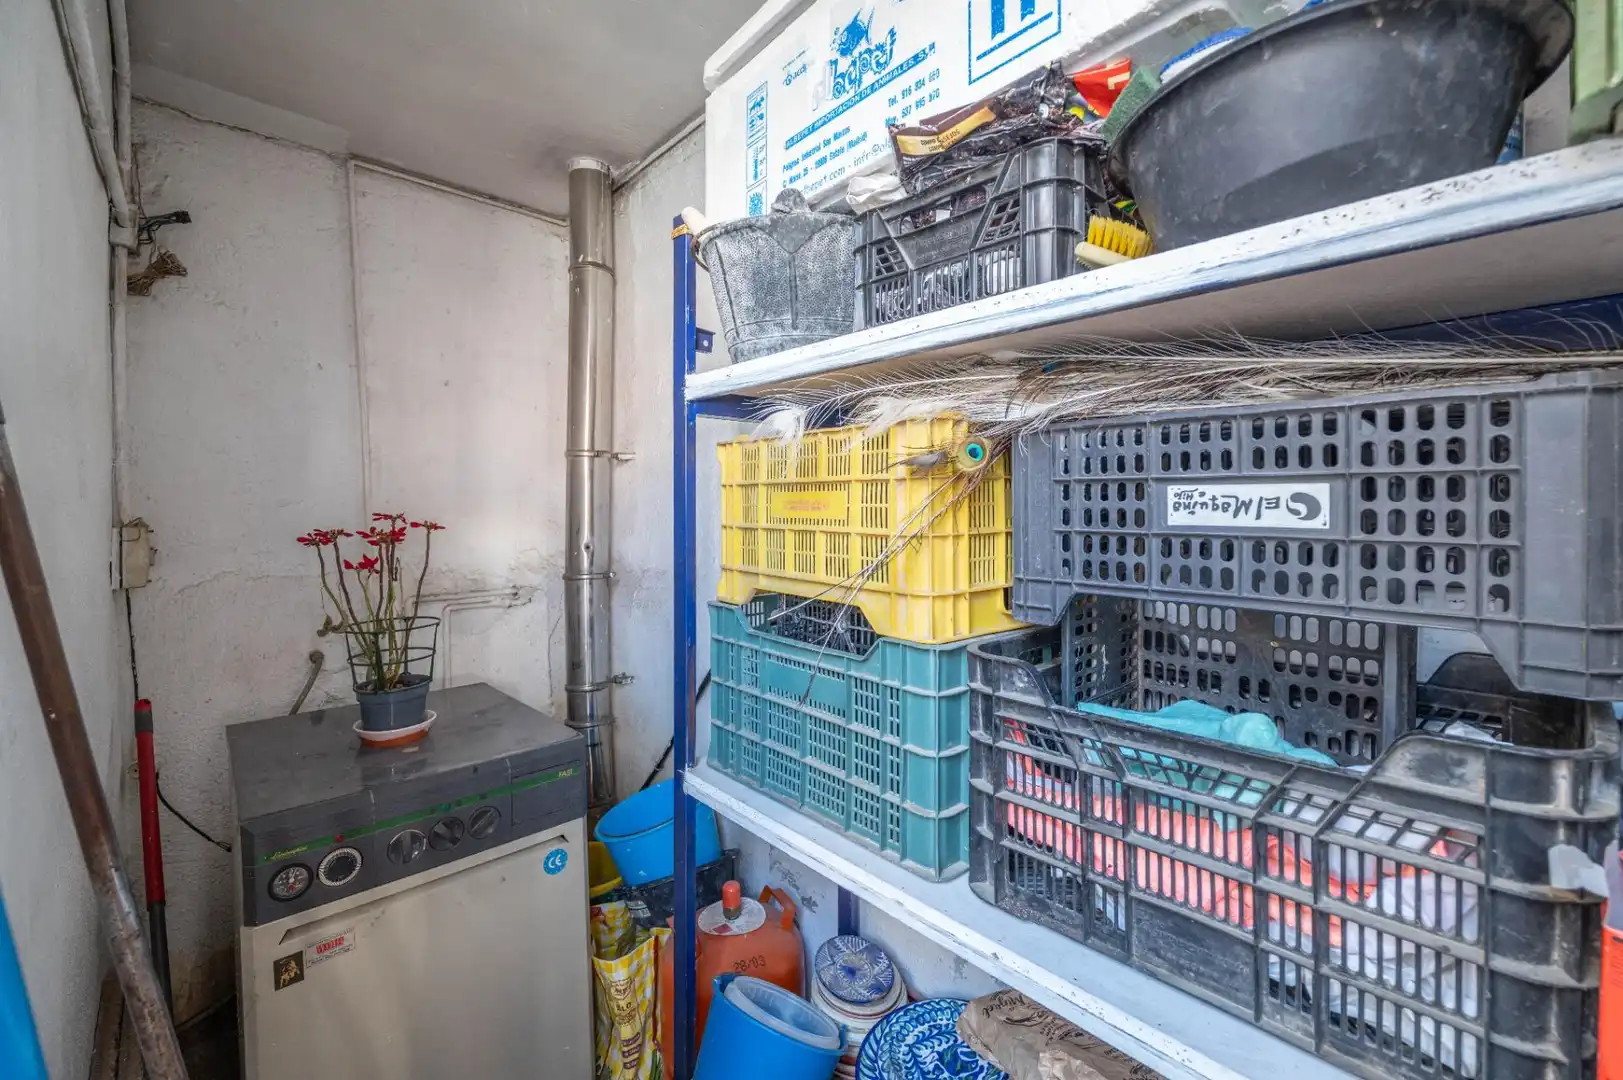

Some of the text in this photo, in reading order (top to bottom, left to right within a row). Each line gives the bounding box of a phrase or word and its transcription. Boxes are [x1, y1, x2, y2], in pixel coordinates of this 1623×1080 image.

[861, 84, 873, 101] DE
[1255, 496, 1281, 521] El
[558, 768, 573, 779] FAST
